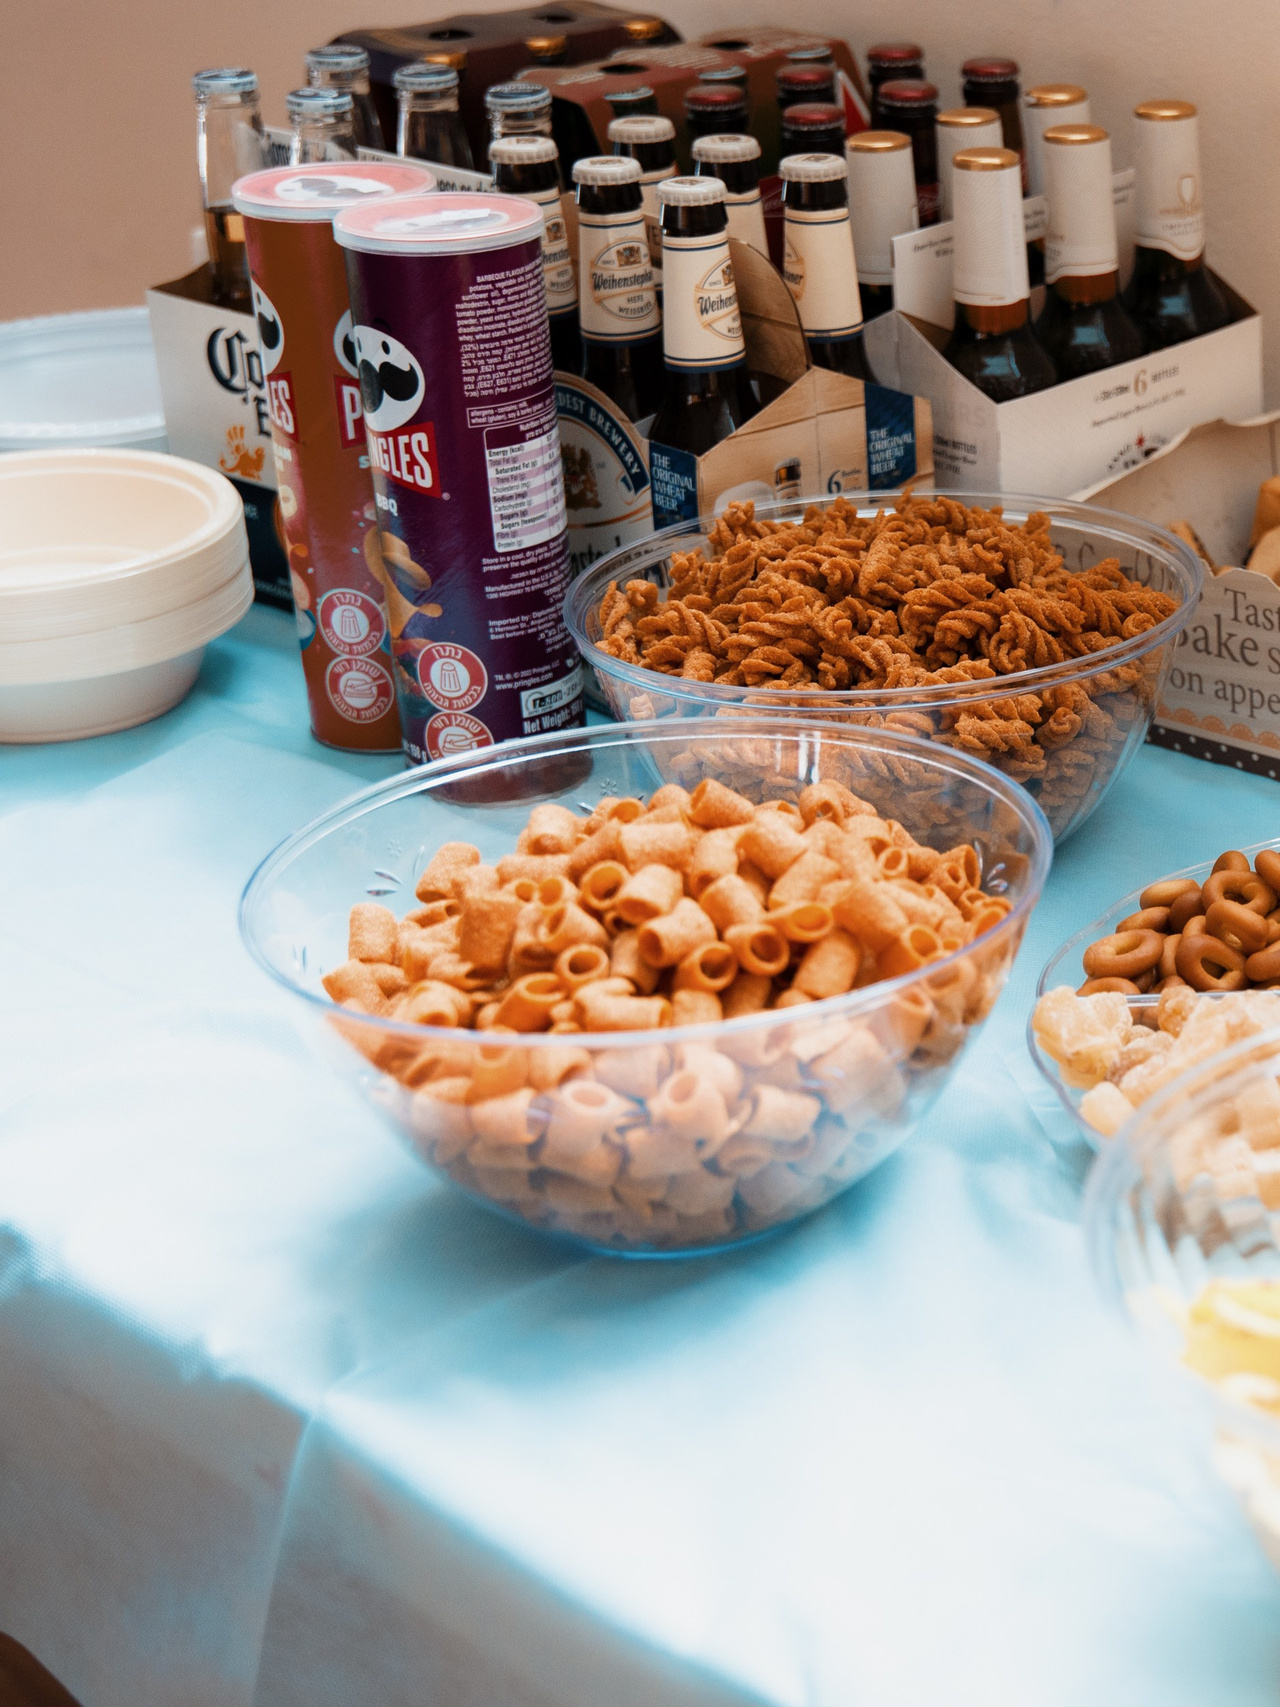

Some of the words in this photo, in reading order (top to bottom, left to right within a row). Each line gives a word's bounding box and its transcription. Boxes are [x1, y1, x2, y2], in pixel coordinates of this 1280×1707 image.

[476, 272, 505, 283] BARBEQUE
[506, 267, 525, 277] FLAVOUR
[469, 284, 494, 293] potatoes,
[495, 279, 517, 288] vegetable
[455, 301, 491, 310] maltodextrin,
[491, 298, 507, 306] sugar,
[457, 319, 479, 327] powder,
[479, 316, 494, 324] yeast
[494, 313, 511, 321] extract,
[476, 308, 497, 317] powder,
[491, 330, 508, 338] starch.
[1133, 368, 1148, 397] 6
[470, 409, 494, 417] allergens
[519, 419, 540, 431] Nutrition
[556, 391, 586, 414] DEST
[589, 406, 641, 476] BREWERY
[869, 427, 889, 441] THE
[869, 432, 915, 453] ORIGINAL
[370, 432, 433, 488] NGLES
[488, 449, 508, 458] Energy
[651, 452, 671, 470] THE
[870, 446, 904, 463] WHEAT
[495, 465, 522, 475] Saturated
[870, 459, 896, 475] BEER
[510, 473, 519, 481] Fat
[652, 467, 696, 492] ORIGINAL
[827, 470, 842, 494] 6
[492, 483, 520, 494] Cholesterol
[652, 479, 686, 501] WHEAT
[376, 493, 398, 517] BBQ
[493, 494, 514, 503] Sodium
[494, 501, 526, 512] Carbohydrate
[654, 493, 678, 511] BEER
[500, 512, 519, 521] Sugars
[501, 521, 520, 530] Sugars
[497, 541, 515, 549] Protein
[483, 563, 510, 573] preserve
[484, 581, 525, 592] Manufactured
[499, 589, 524, 597] HIGHWAY
[333, 593, 362, 606] נתרן
[488, 616, 520, 626] Imported
[495, 624, 519, 632] Hermon
[530, 616, 548, 626] Airport
[325, 628, 350, 653] גבוהה
[352, 631, 381, 655] בכמות
[431, 646, 463, 660] נתרן
[352, 660, 381, 678] שומן
[495, 672, 554, 690] www.pringles.com
[1169, 667, 1203, 695] on
[423, 682, 449, 708] גבוהה
[452, 685, 482, 709] בכמות
[333, 693, 358, 718] גבוהה
[359, 697, 388, 719] בכמות
[451, 714, 482, 734] שומן
[523, 719, 541, 734] Net
[541, 709, 571, 729] Weight:
